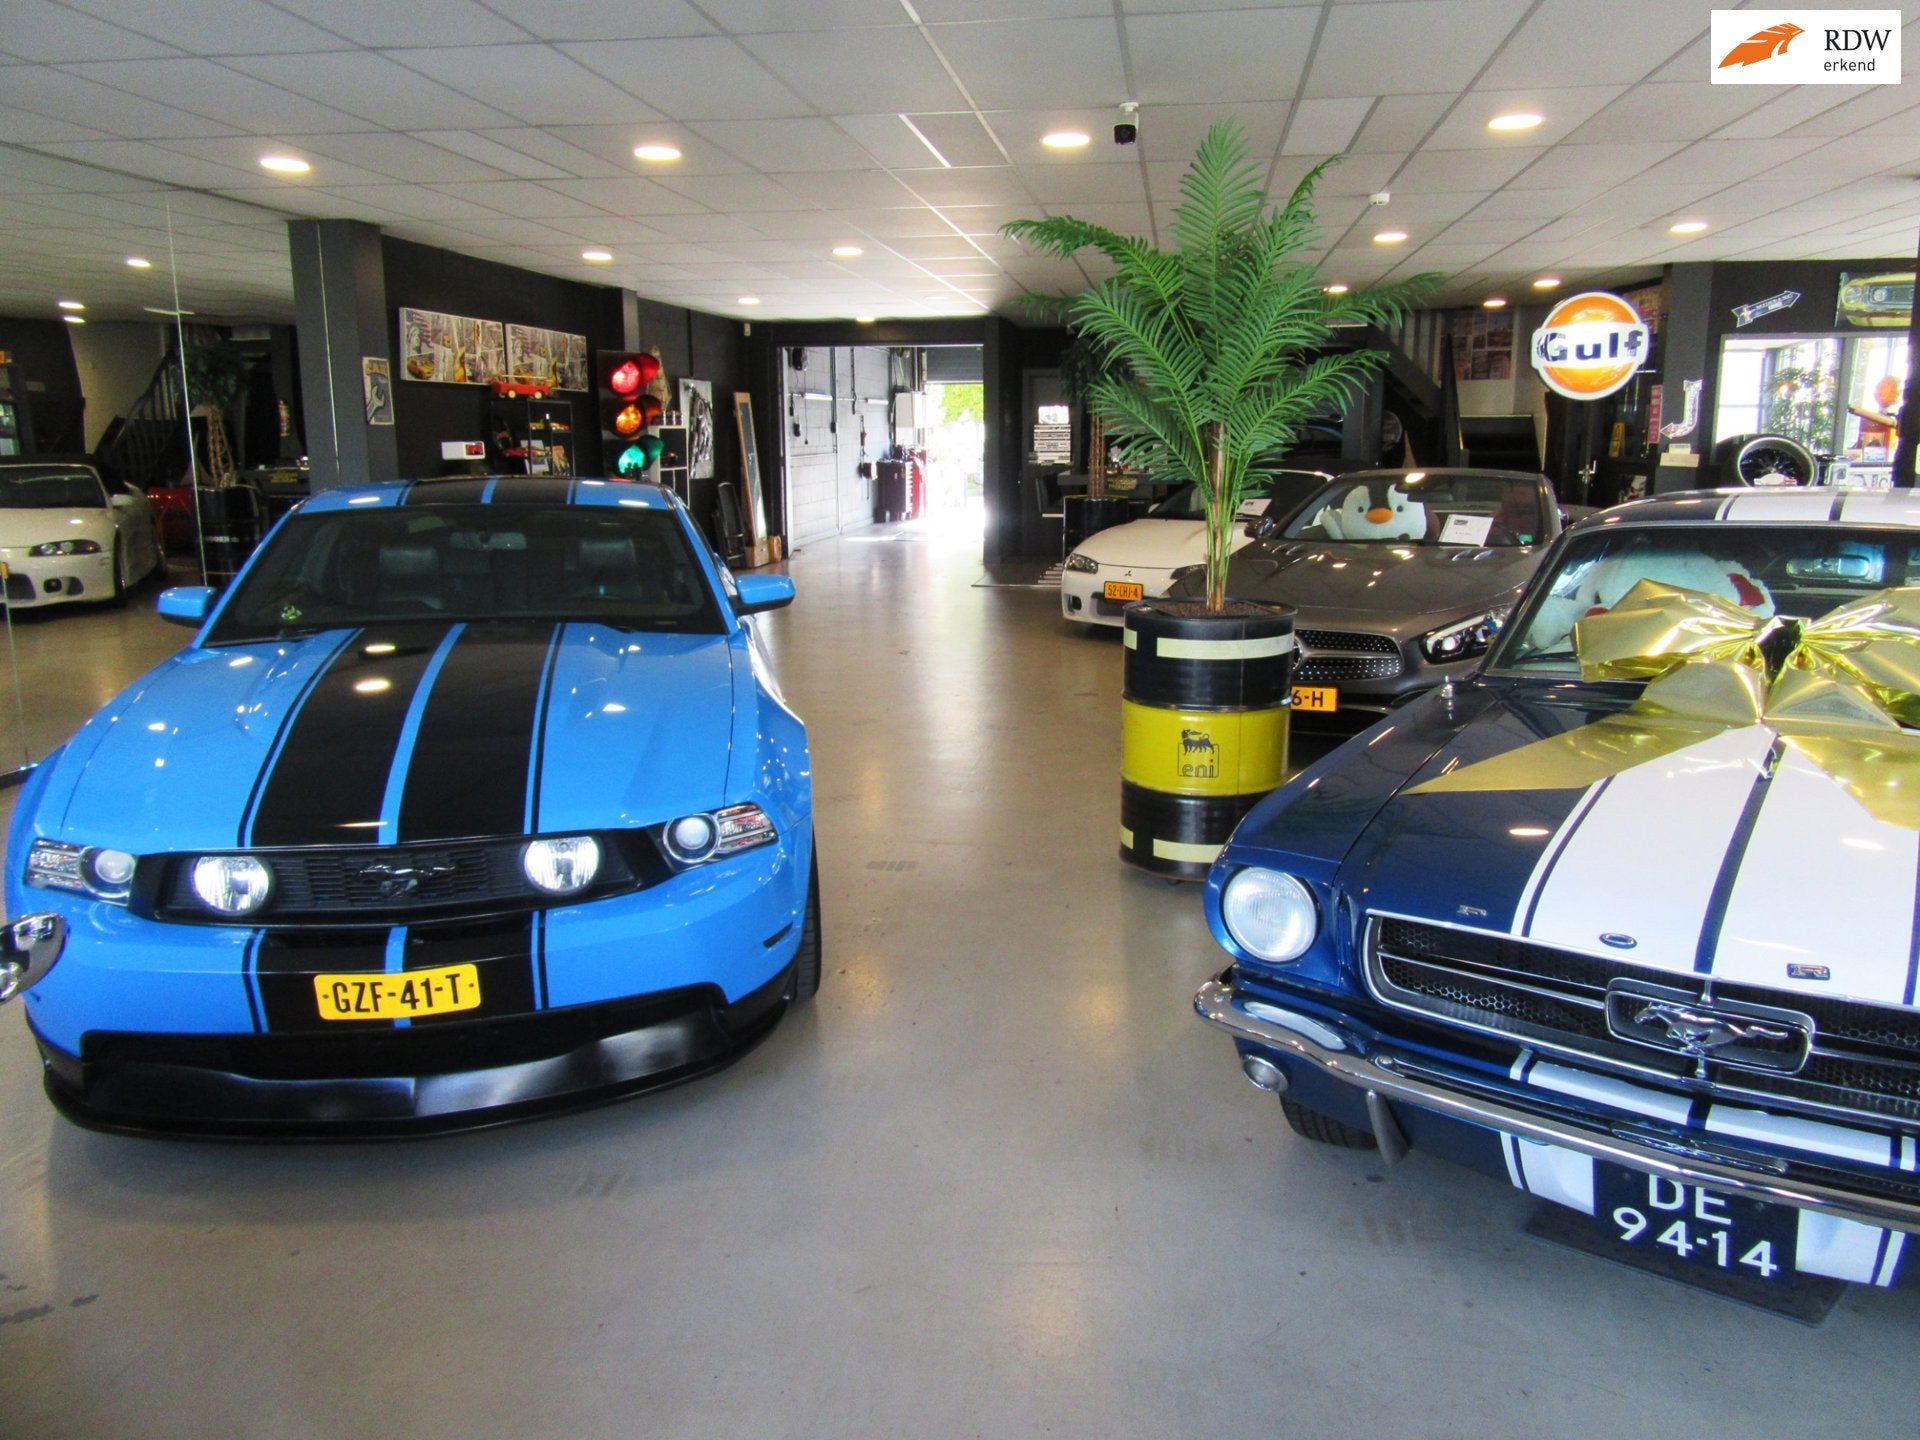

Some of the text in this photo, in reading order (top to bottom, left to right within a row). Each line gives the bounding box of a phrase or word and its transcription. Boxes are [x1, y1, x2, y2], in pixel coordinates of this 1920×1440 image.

[1536, 330, 1643, 361] Gulf
[1181, 759, 1214, 778] eni
[332, 973, 461, 1014] GZF-41-T
[1648, 1173, 1732, 1225] DE
[1612, 1206, 1778, 1277] 94-14
